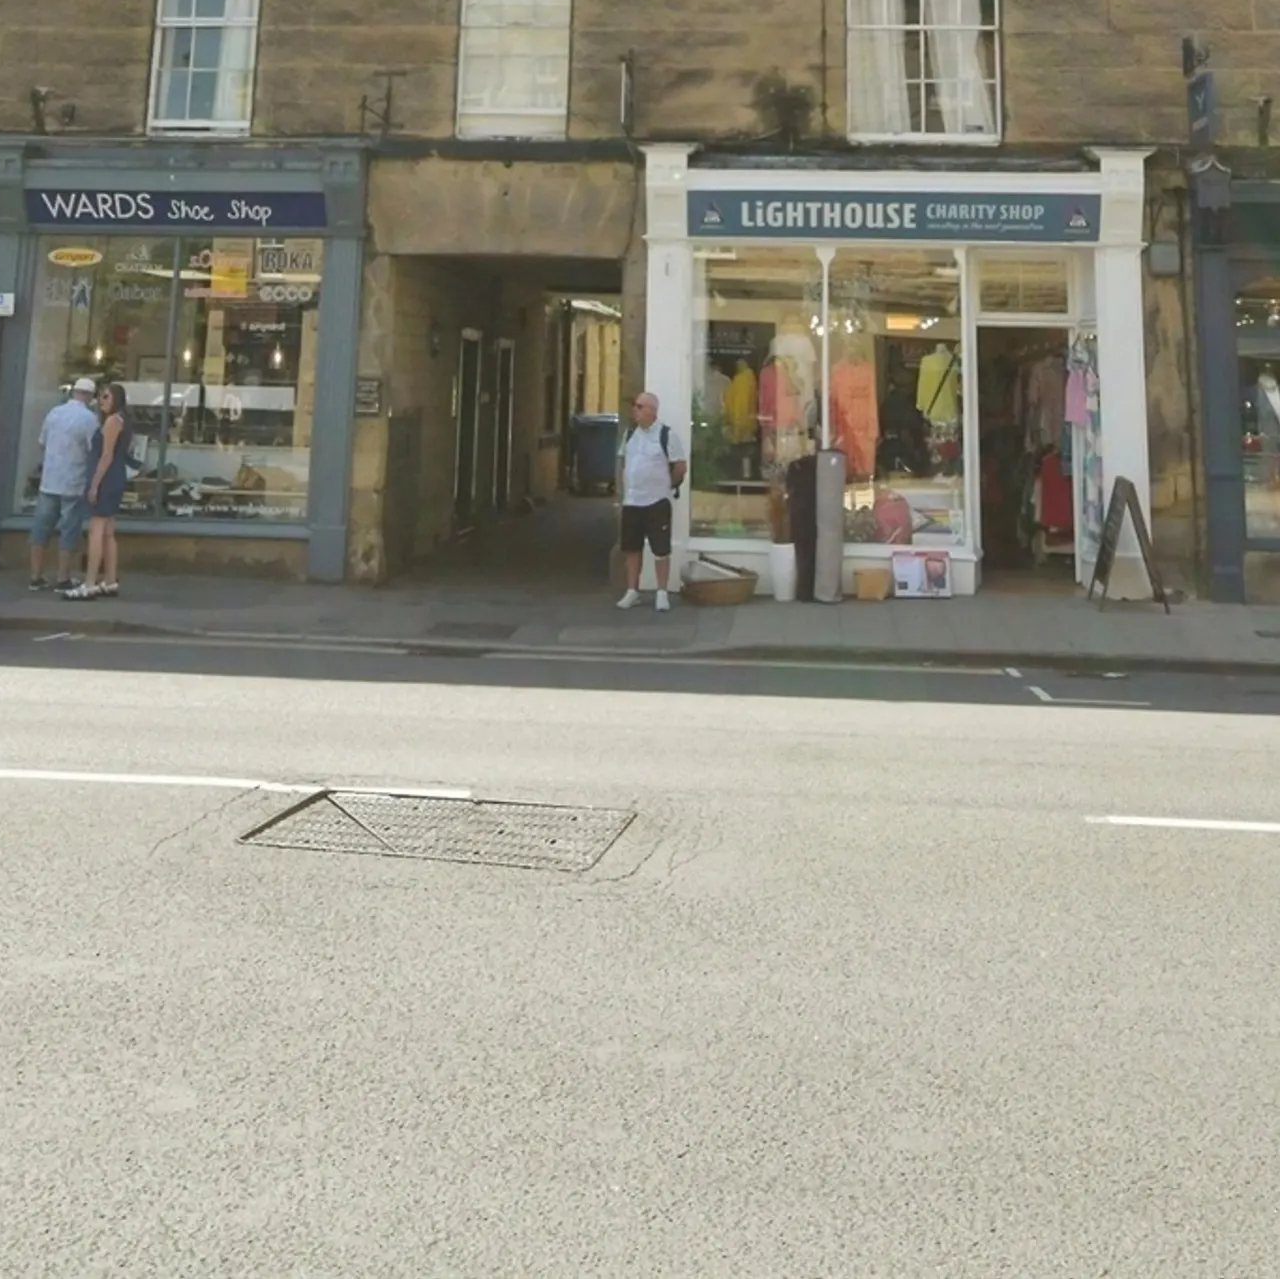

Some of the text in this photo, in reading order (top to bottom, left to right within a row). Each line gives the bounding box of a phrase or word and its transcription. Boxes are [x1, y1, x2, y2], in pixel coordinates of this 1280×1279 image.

[41, 193, 271, 226] WARDS Shoe Shop
[926, 203, 996, 220] CHARITY
[999, 204, 1046, 221] SHOP
[264, 250, 313, 270] ROKA
[259, 285, 313, 302] ecco
